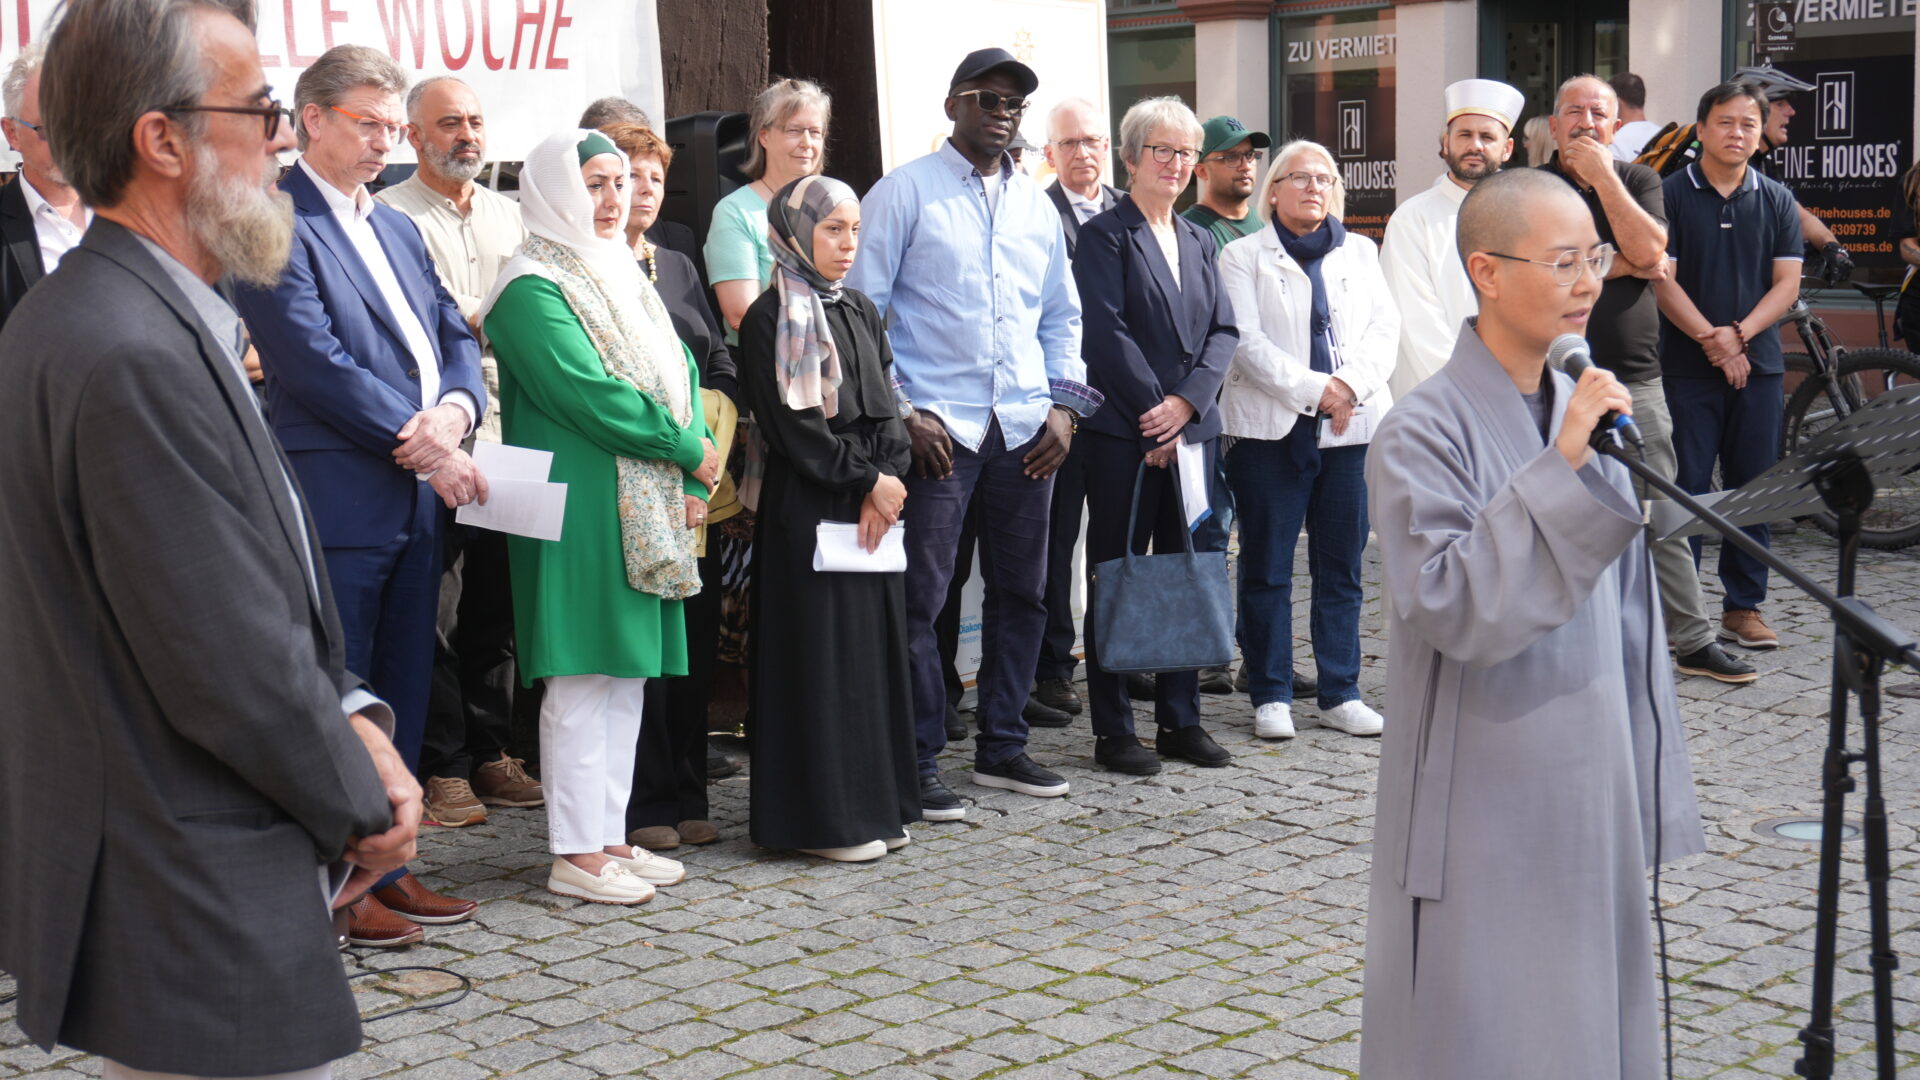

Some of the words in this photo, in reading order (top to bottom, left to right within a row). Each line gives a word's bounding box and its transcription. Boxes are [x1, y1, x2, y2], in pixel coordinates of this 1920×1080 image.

[377, 0, 573, 71] WOCHE
[1288, 40, 1312, 62] ZU
[1317, 33, 1398, 60] VERMIET
[1344, 161, 1397, 190] HOUSES
[1775, 146, 1815, 179] FINE
[1822, 143, 1898, 179] HOUSES
[1830, 223, 1876, 236] 6309739
[1842, 241, 1893, 253] ouses.de
